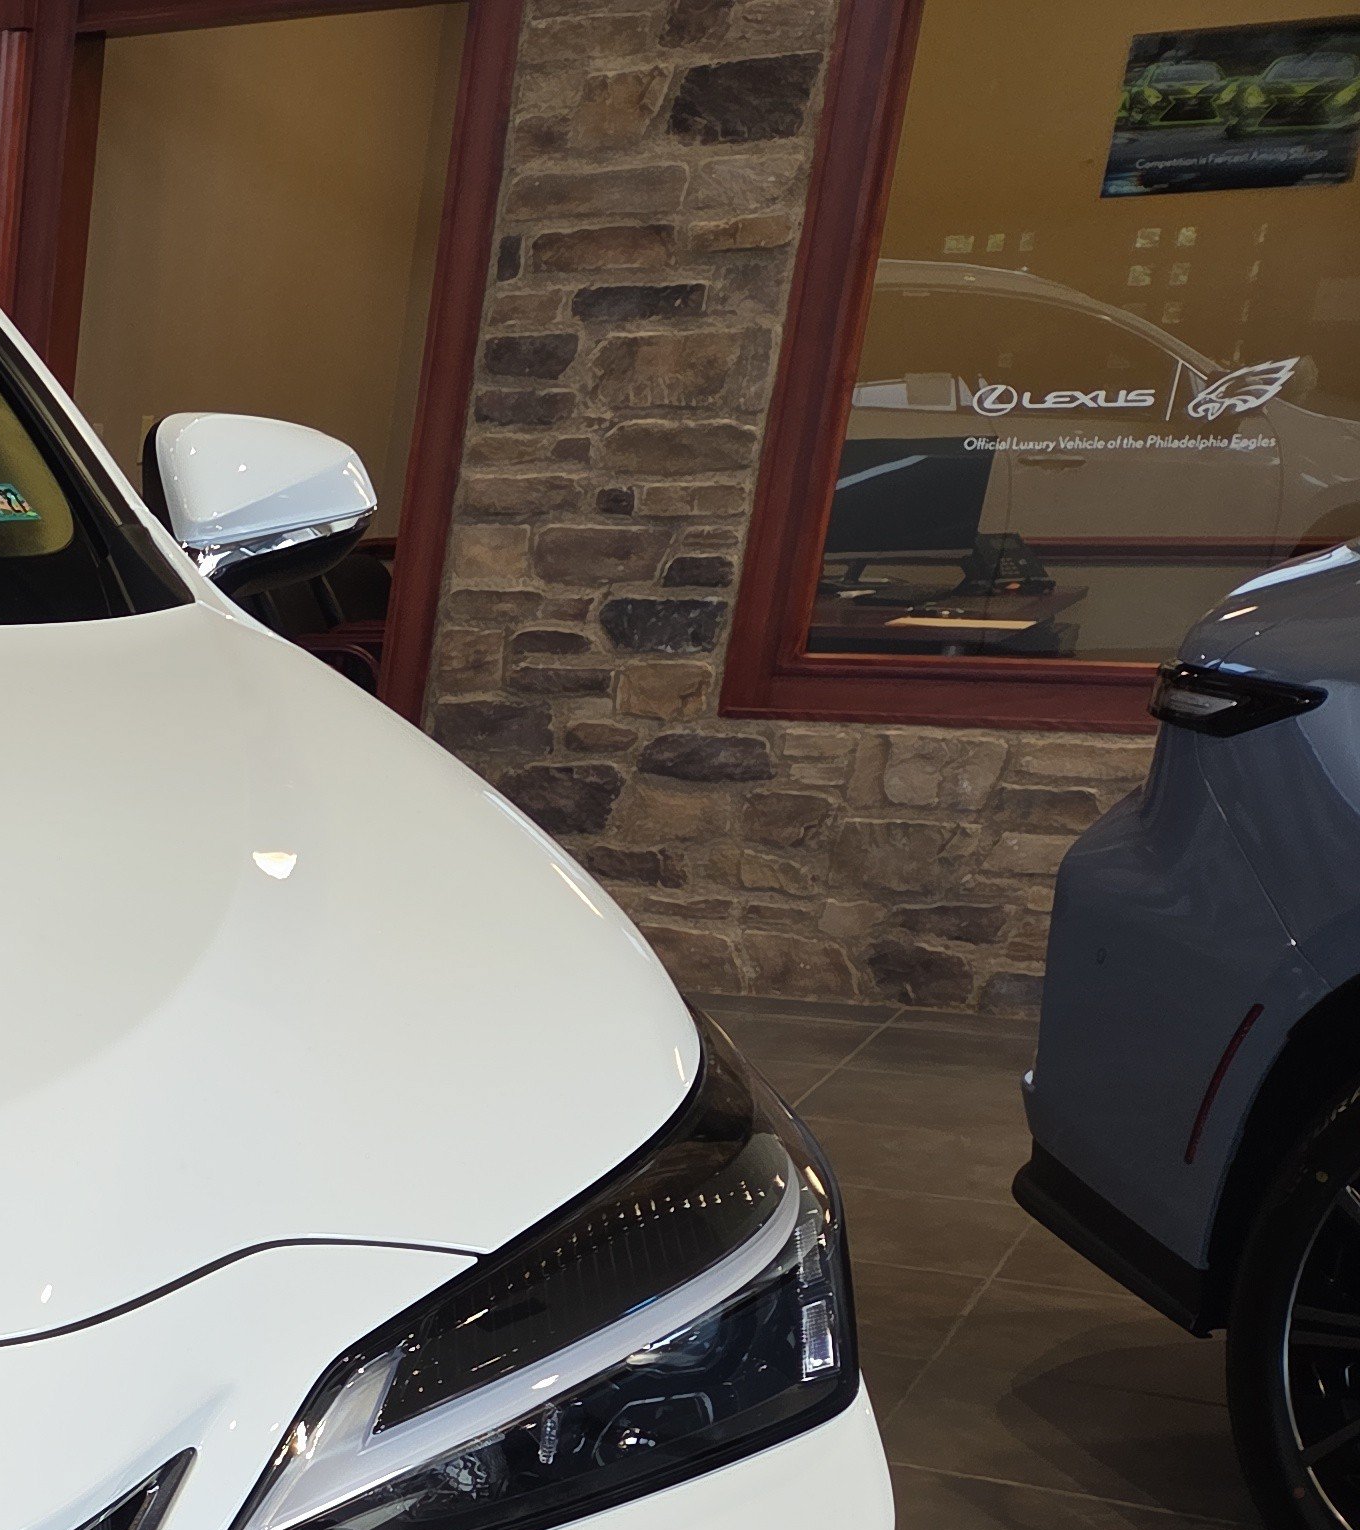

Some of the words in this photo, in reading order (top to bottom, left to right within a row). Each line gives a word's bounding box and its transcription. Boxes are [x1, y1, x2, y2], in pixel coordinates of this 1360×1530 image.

[1022, 389, 1156, 409] LEXUS
[963, 436, 1010, 451] Official
[1012, 436, 1056, 452] Luxury
[1058, 435, 1105, 449] Vehicle
[1107, 435, 1121, 449] of
[1122, 435, 1144, 448] the
[1146, 434, 1229, 450] Philadelphia
[1230, 433, 1277, 450] Eagles
